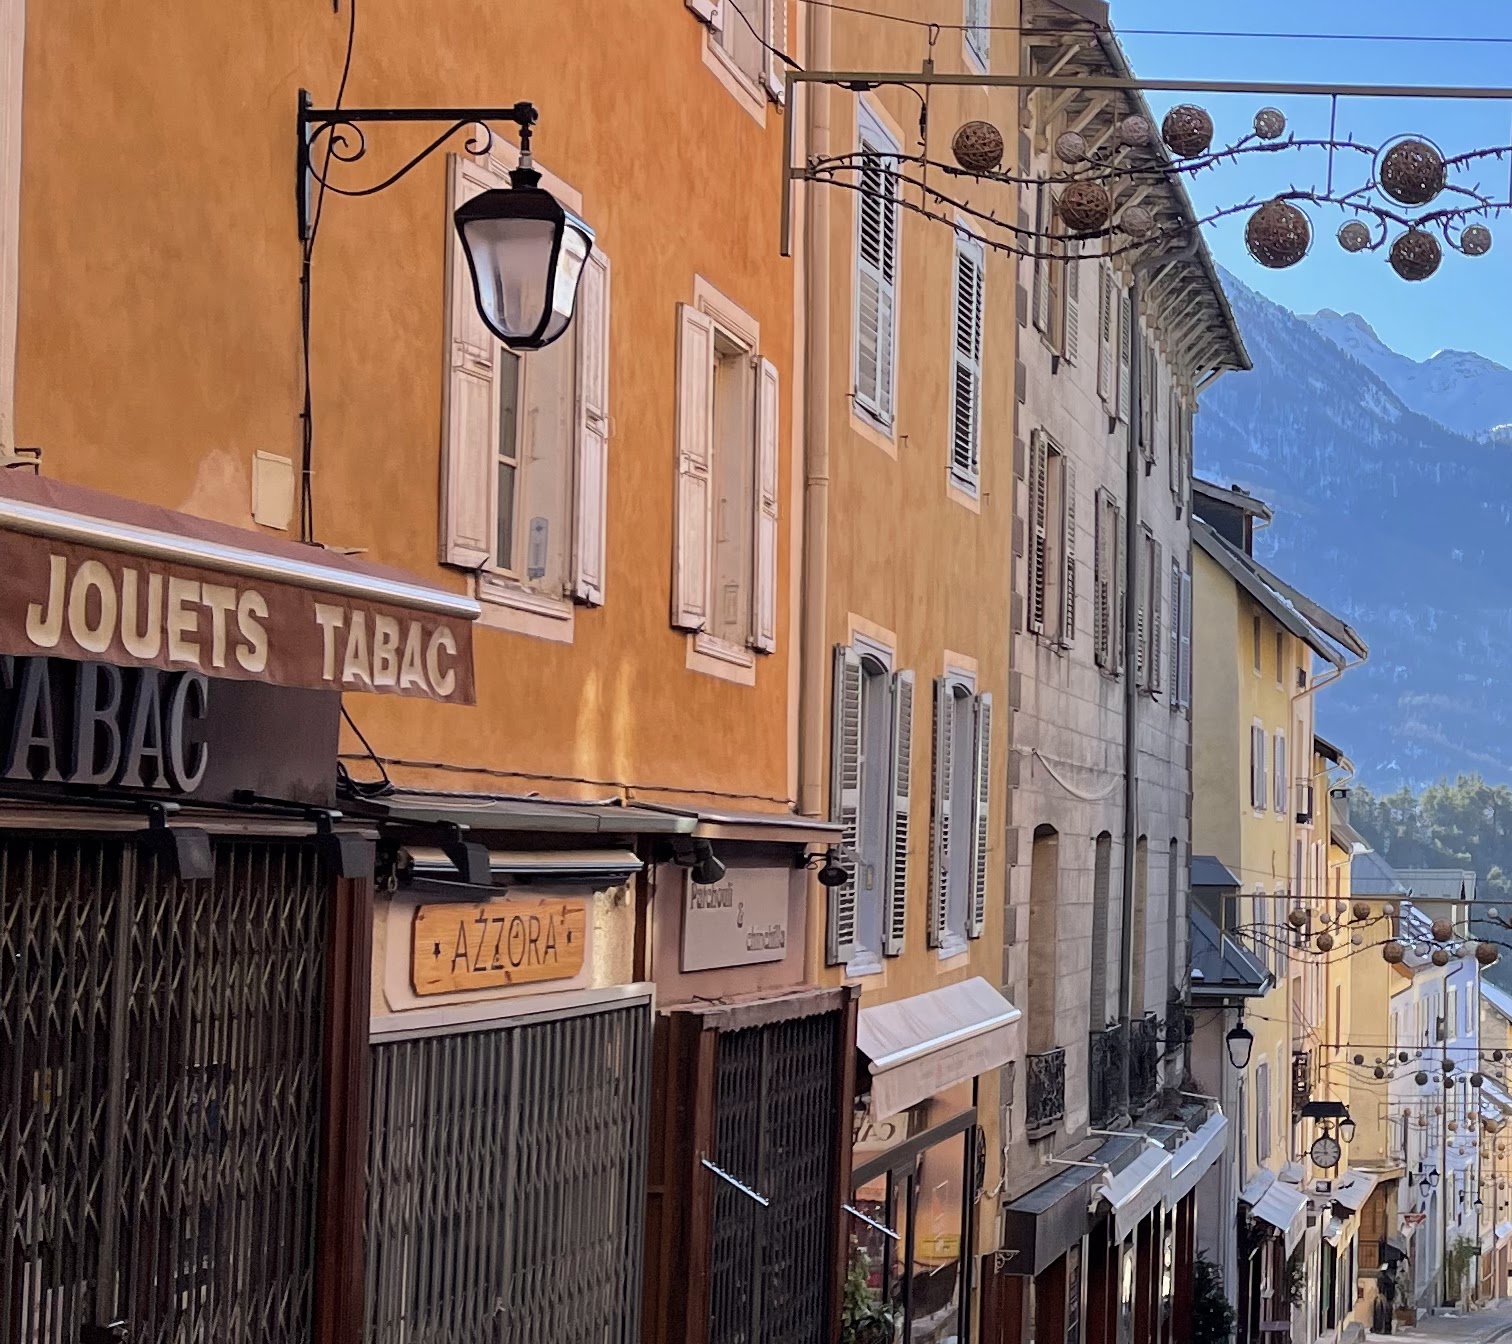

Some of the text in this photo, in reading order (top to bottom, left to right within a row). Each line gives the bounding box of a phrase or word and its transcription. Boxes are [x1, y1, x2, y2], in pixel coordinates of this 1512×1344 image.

[26, 554, 457, 697] JOUETS TABAC
[0, 656, 208, 794] ABAC
